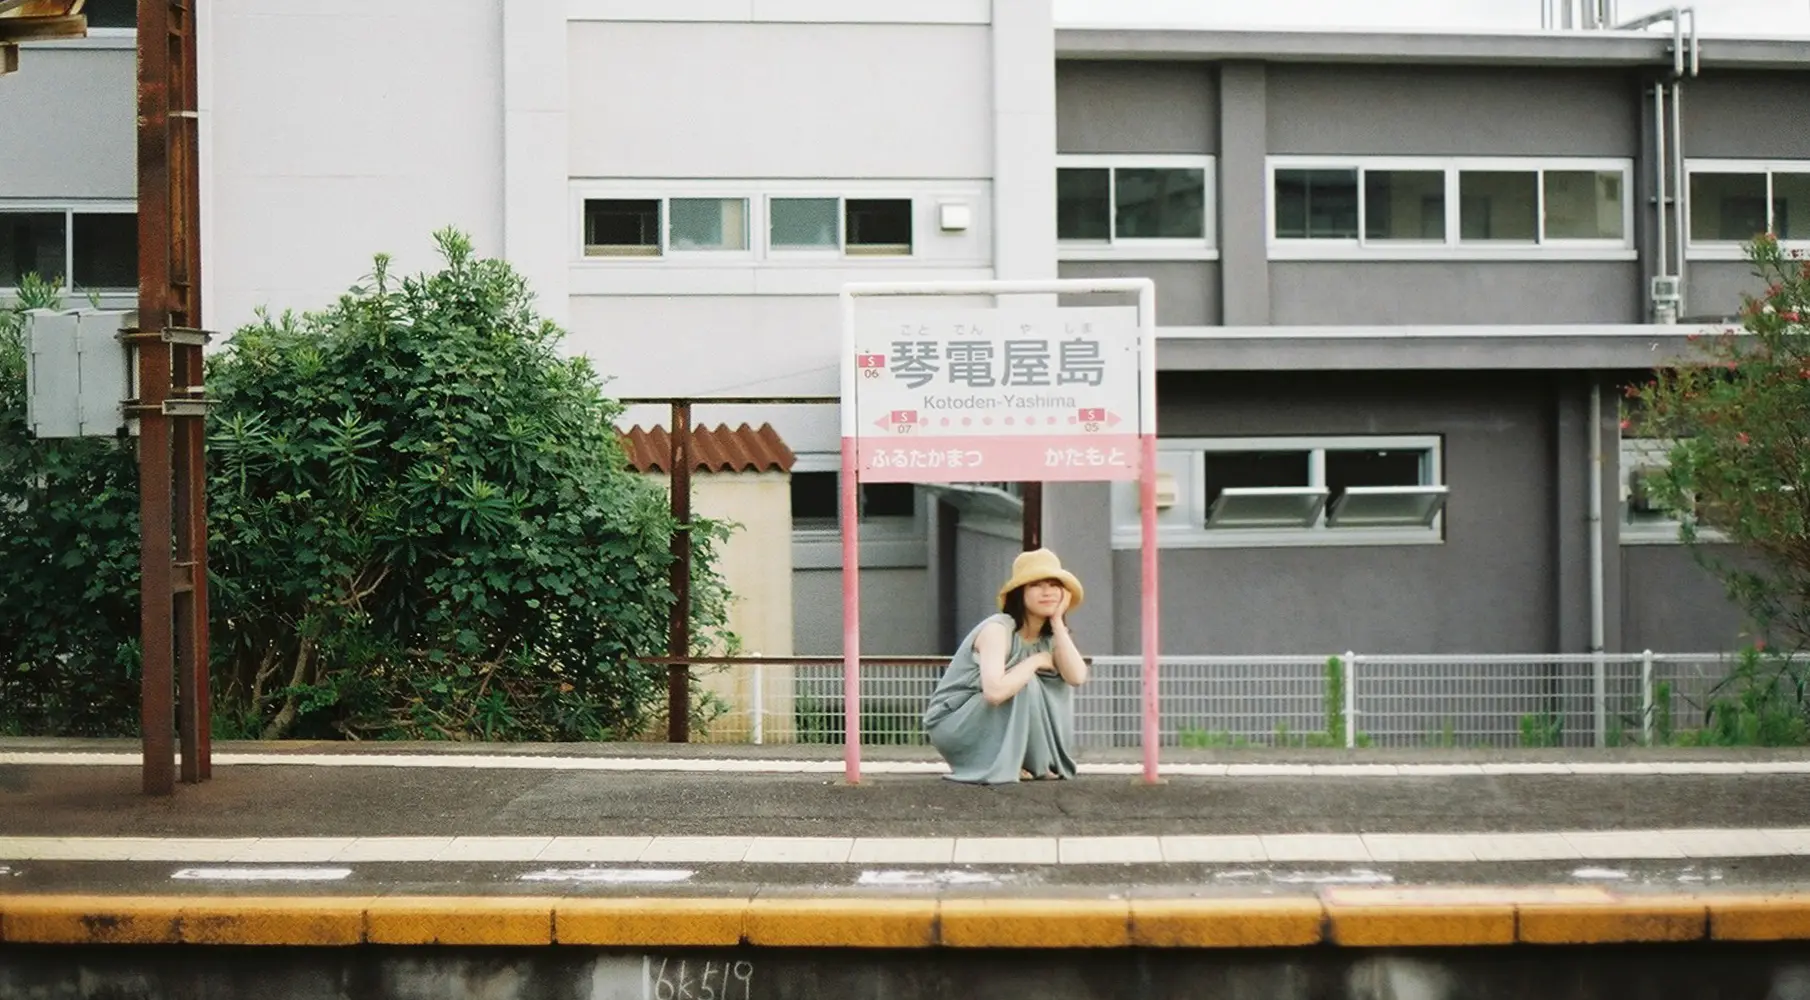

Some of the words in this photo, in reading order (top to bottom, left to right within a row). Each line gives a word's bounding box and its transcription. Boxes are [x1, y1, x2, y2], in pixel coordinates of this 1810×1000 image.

[890, 337, 1105, 389] 琴電屋島
[864, 369, 879, 379] 06
[924, 395, 1076, 409] Kotoden-Yashima
[897, 424, 912, 434] 07
[1084, 422, 1099, 432] 05
[872, 448, 983, 468] ふるたかまつ
[1044, 447, 1126, 467] かたもと
